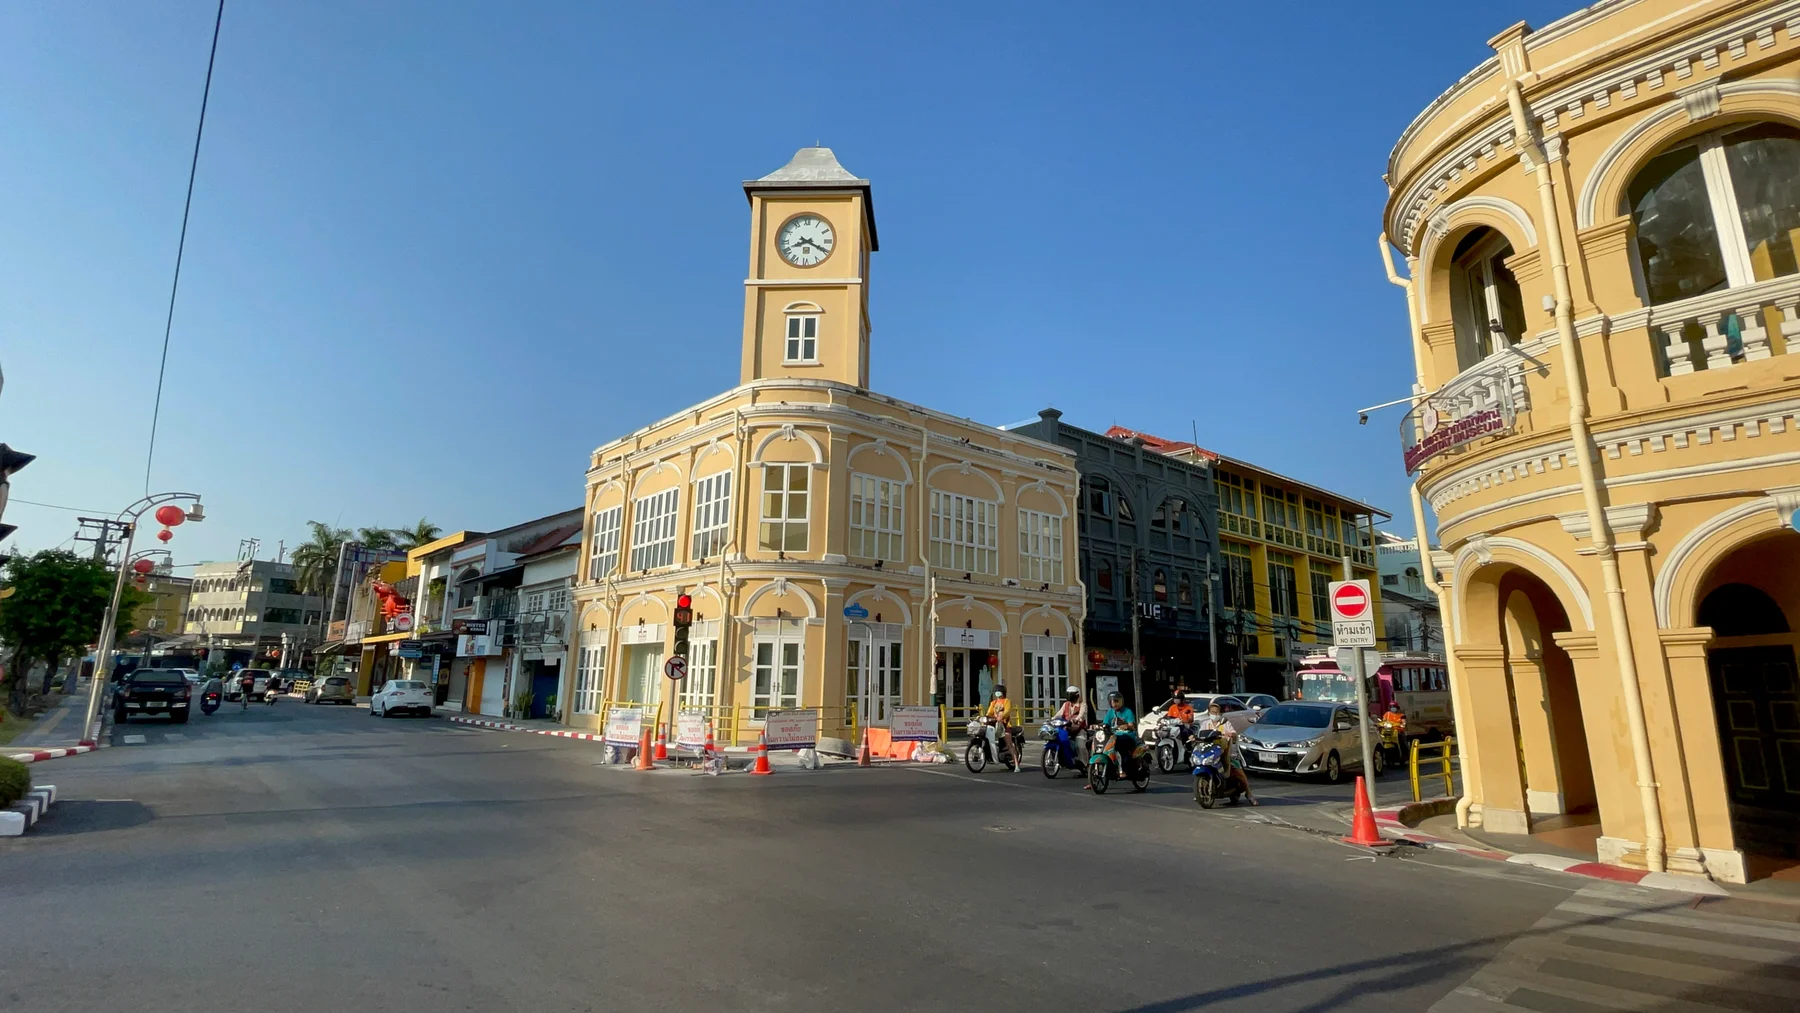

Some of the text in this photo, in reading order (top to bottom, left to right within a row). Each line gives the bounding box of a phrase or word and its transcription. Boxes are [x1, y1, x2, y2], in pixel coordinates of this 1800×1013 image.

[1453, 418, 1504, 444] MUSEUM
[1336, 622, 1371, 635] ห้ามเข้า
